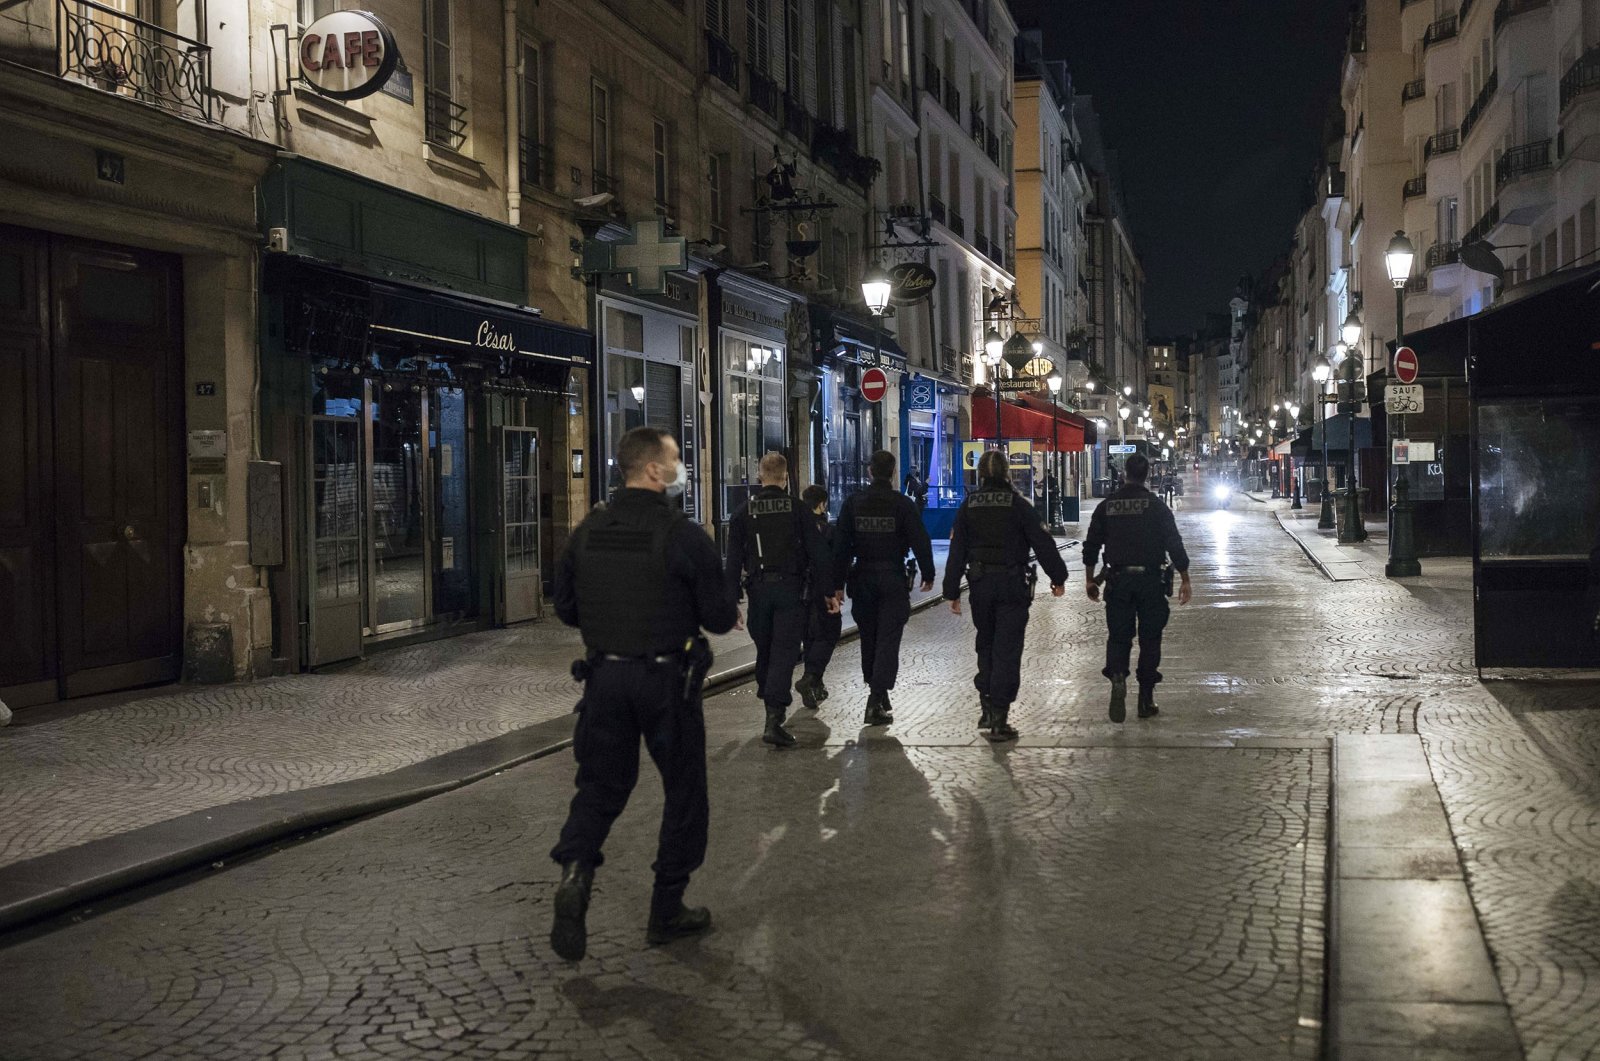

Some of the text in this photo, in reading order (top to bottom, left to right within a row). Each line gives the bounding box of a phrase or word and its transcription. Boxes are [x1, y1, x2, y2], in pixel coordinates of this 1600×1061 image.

[301, 30, 380, 71] CAFE
[476, 320, 516, 352] César
[198, 384, 213, 395] 47
[970, 492, 1011, 504] POLICE
[750, 500, 790, 513] POLICE
[1107, 500, 1149, 513] POLICE
[855, 518, 894, 530] POLICE
